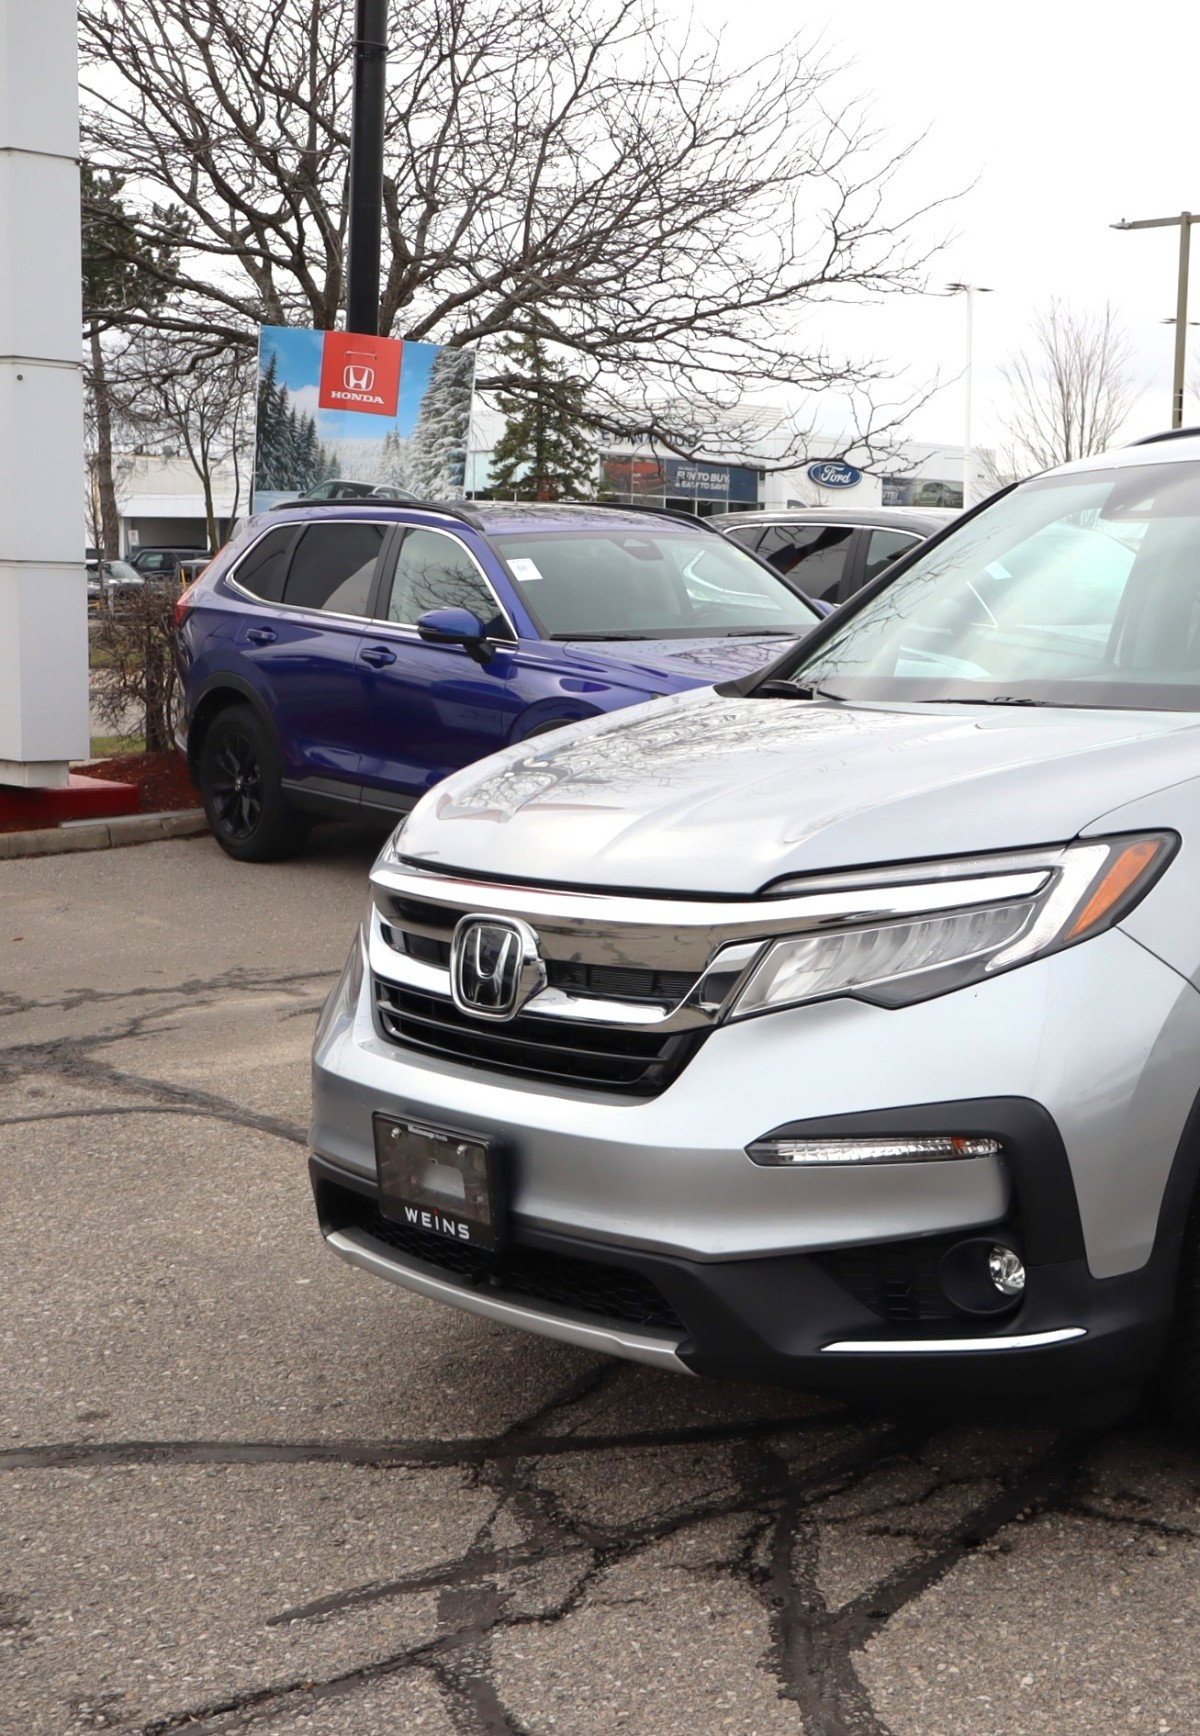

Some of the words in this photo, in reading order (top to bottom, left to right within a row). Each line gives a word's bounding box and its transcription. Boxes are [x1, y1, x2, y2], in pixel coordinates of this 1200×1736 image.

[330, 390, 384, 404] HONDA
[697, 472, 709, 481] TO
[821, 465, 851, 483] Ford
[404, 1206, 470, 1240] WEINS
